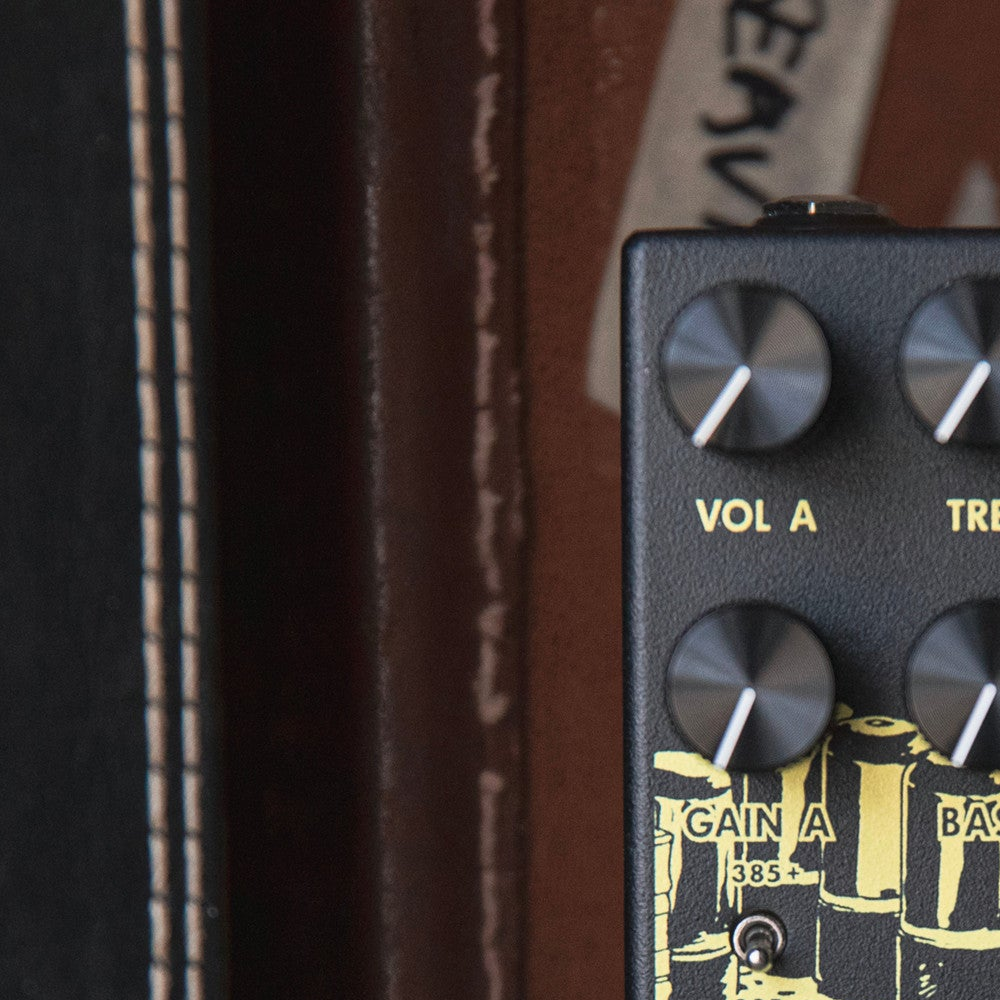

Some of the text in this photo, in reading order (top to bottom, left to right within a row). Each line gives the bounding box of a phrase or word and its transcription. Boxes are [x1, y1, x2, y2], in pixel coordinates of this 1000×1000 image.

[696, 499, 818, 532] VOL A
[685, 806, 831, 838] GAIN A
